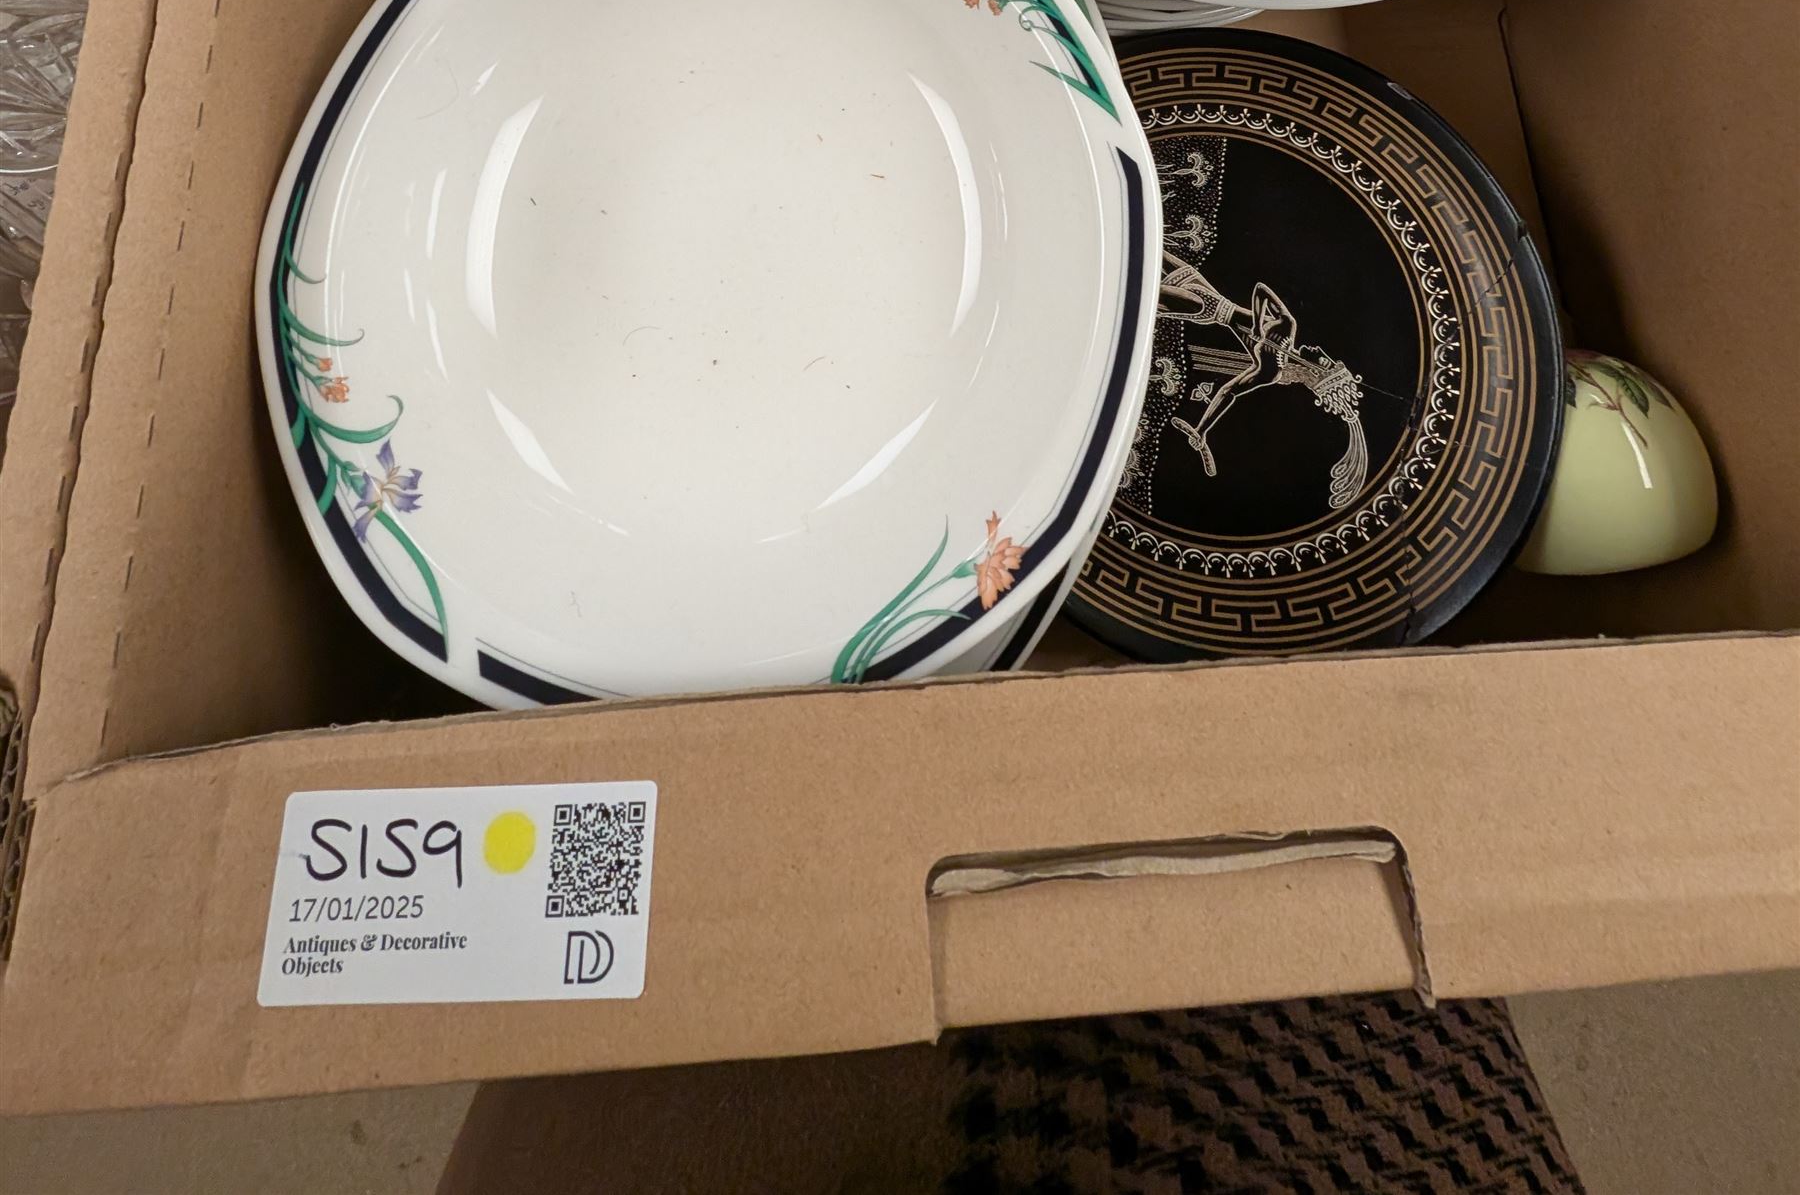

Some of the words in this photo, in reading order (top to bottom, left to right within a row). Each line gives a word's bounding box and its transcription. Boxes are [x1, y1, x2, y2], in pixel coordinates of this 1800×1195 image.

[289, 894, 424, 923] 17/01/2025
[284, 935, 356, 955] Antiques
[360, 934, 377, 952] &
[380, 932, 468, 951] Decorative
[281, 955, 343, 976] Objects
